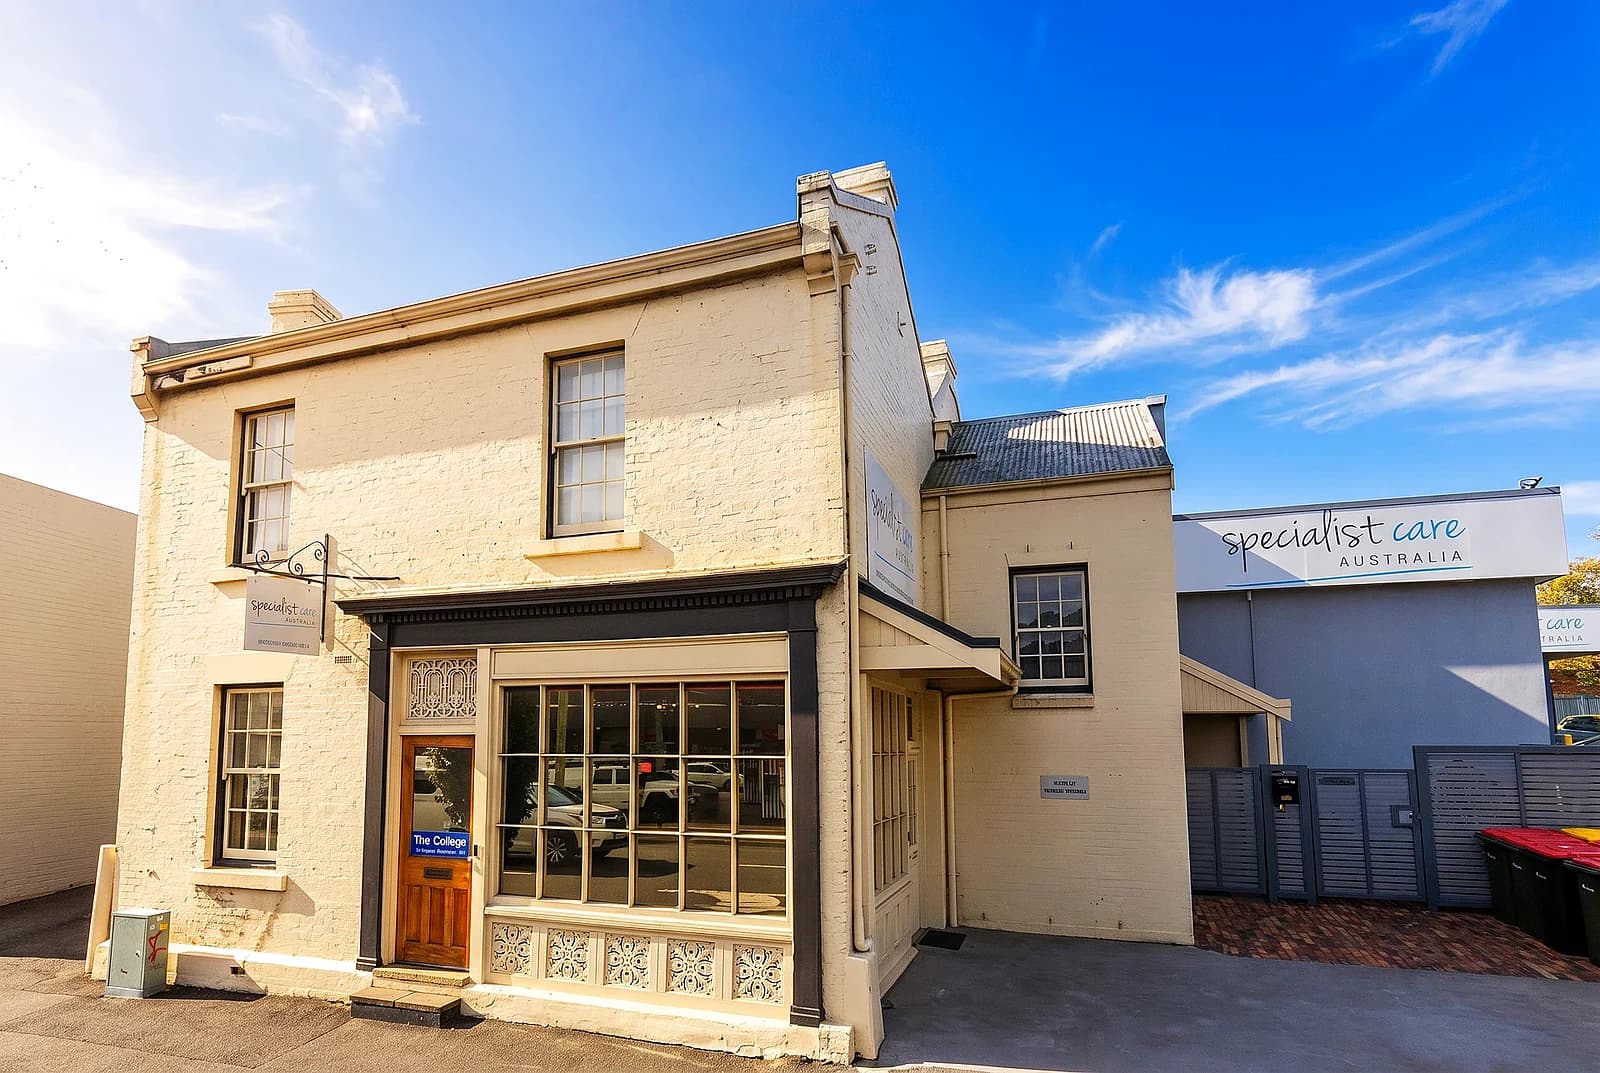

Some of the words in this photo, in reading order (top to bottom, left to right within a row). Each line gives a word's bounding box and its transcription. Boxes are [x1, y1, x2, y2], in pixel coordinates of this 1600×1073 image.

[1222, 509, 1384, 572] specialist
[1391, 519, 1466, 542] care
[1339, 550, 1463, 568] AUSTRALIA
[251, 597, 299, 617] specialist
[299, 607, 319, 618] care
[285, 617, 315, 625] AUSTRALIA
[1546, 618, 1585, 630] care
[413, 835, 431, 846] The
[433, 835, 467, 849] College
